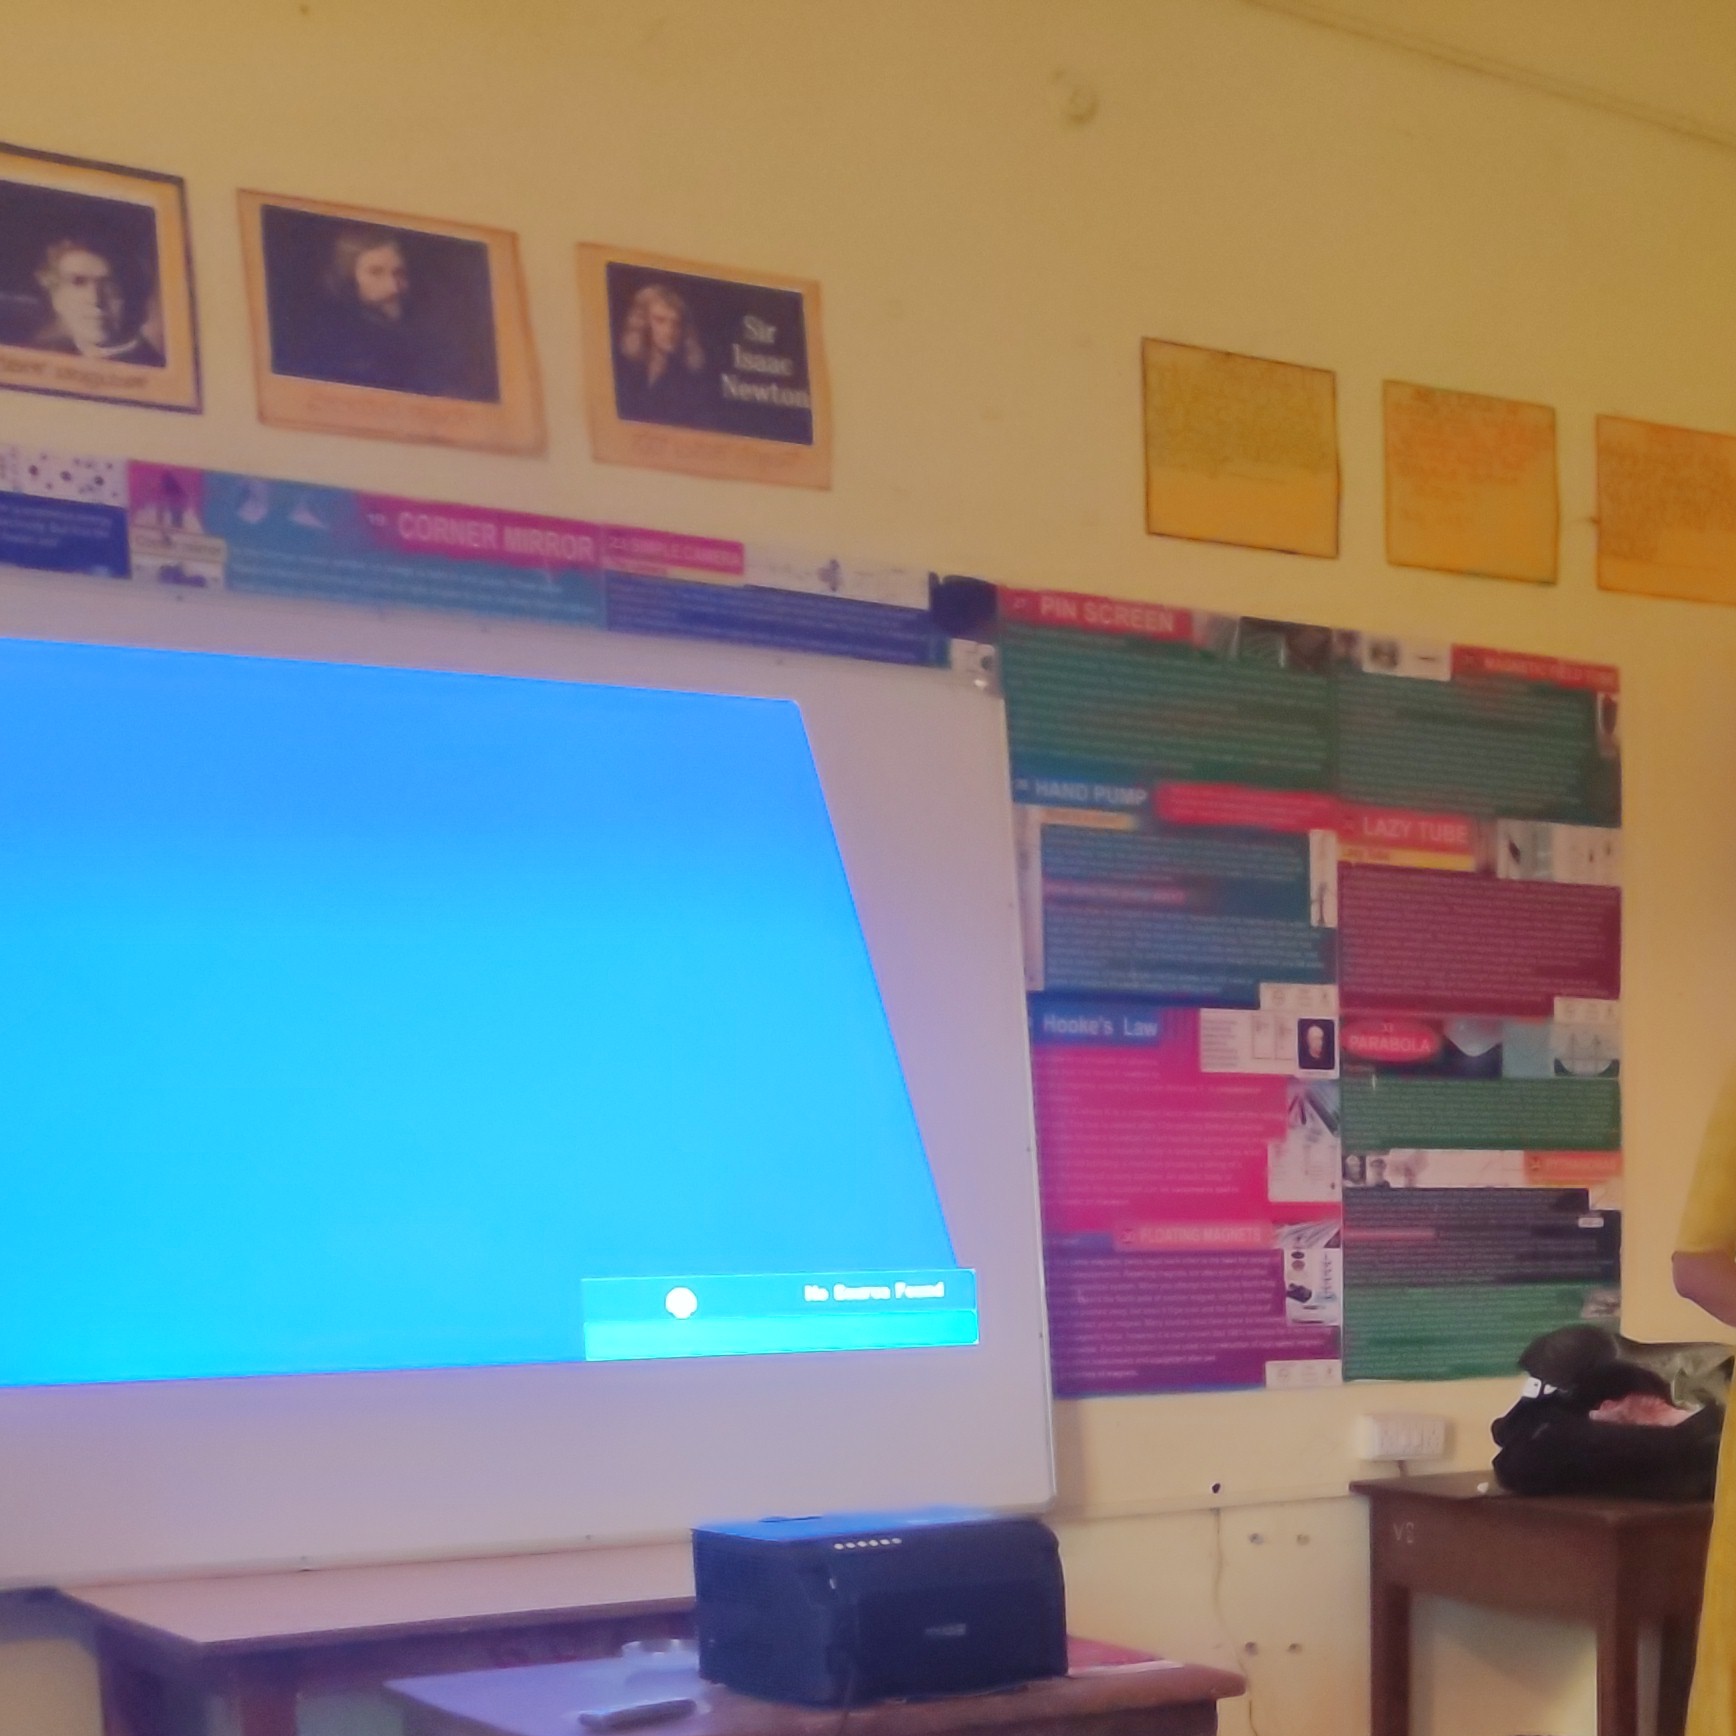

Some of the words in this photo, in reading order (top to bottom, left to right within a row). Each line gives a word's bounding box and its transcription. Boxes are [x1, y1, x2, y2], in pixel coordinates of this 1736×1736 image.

[742, 314, 777, 343] Sir
[732, 343, 794, 377] Isaac
[720, 373, 811, 409] Newton
[399, 511, 497, 549] CORNER
[503, 524, 597, 562] MIRROR
[1039, 595, 1077, 619] PIN
[1083, 599, 1176, 633] SCREEN
[1035, 780, 1088, 803] HAND
[1093, 784, 1149, 806] PUMP
[1362, 816, 1414, 838] LAZY
[1417, 820, 1469, 844] TUBE
[1043, 1013, 1114, 1037] Hooke's
[1122, 1018, 1159, 1038] Law
[1349, 1034, 1432, 1053] PARABOLA
